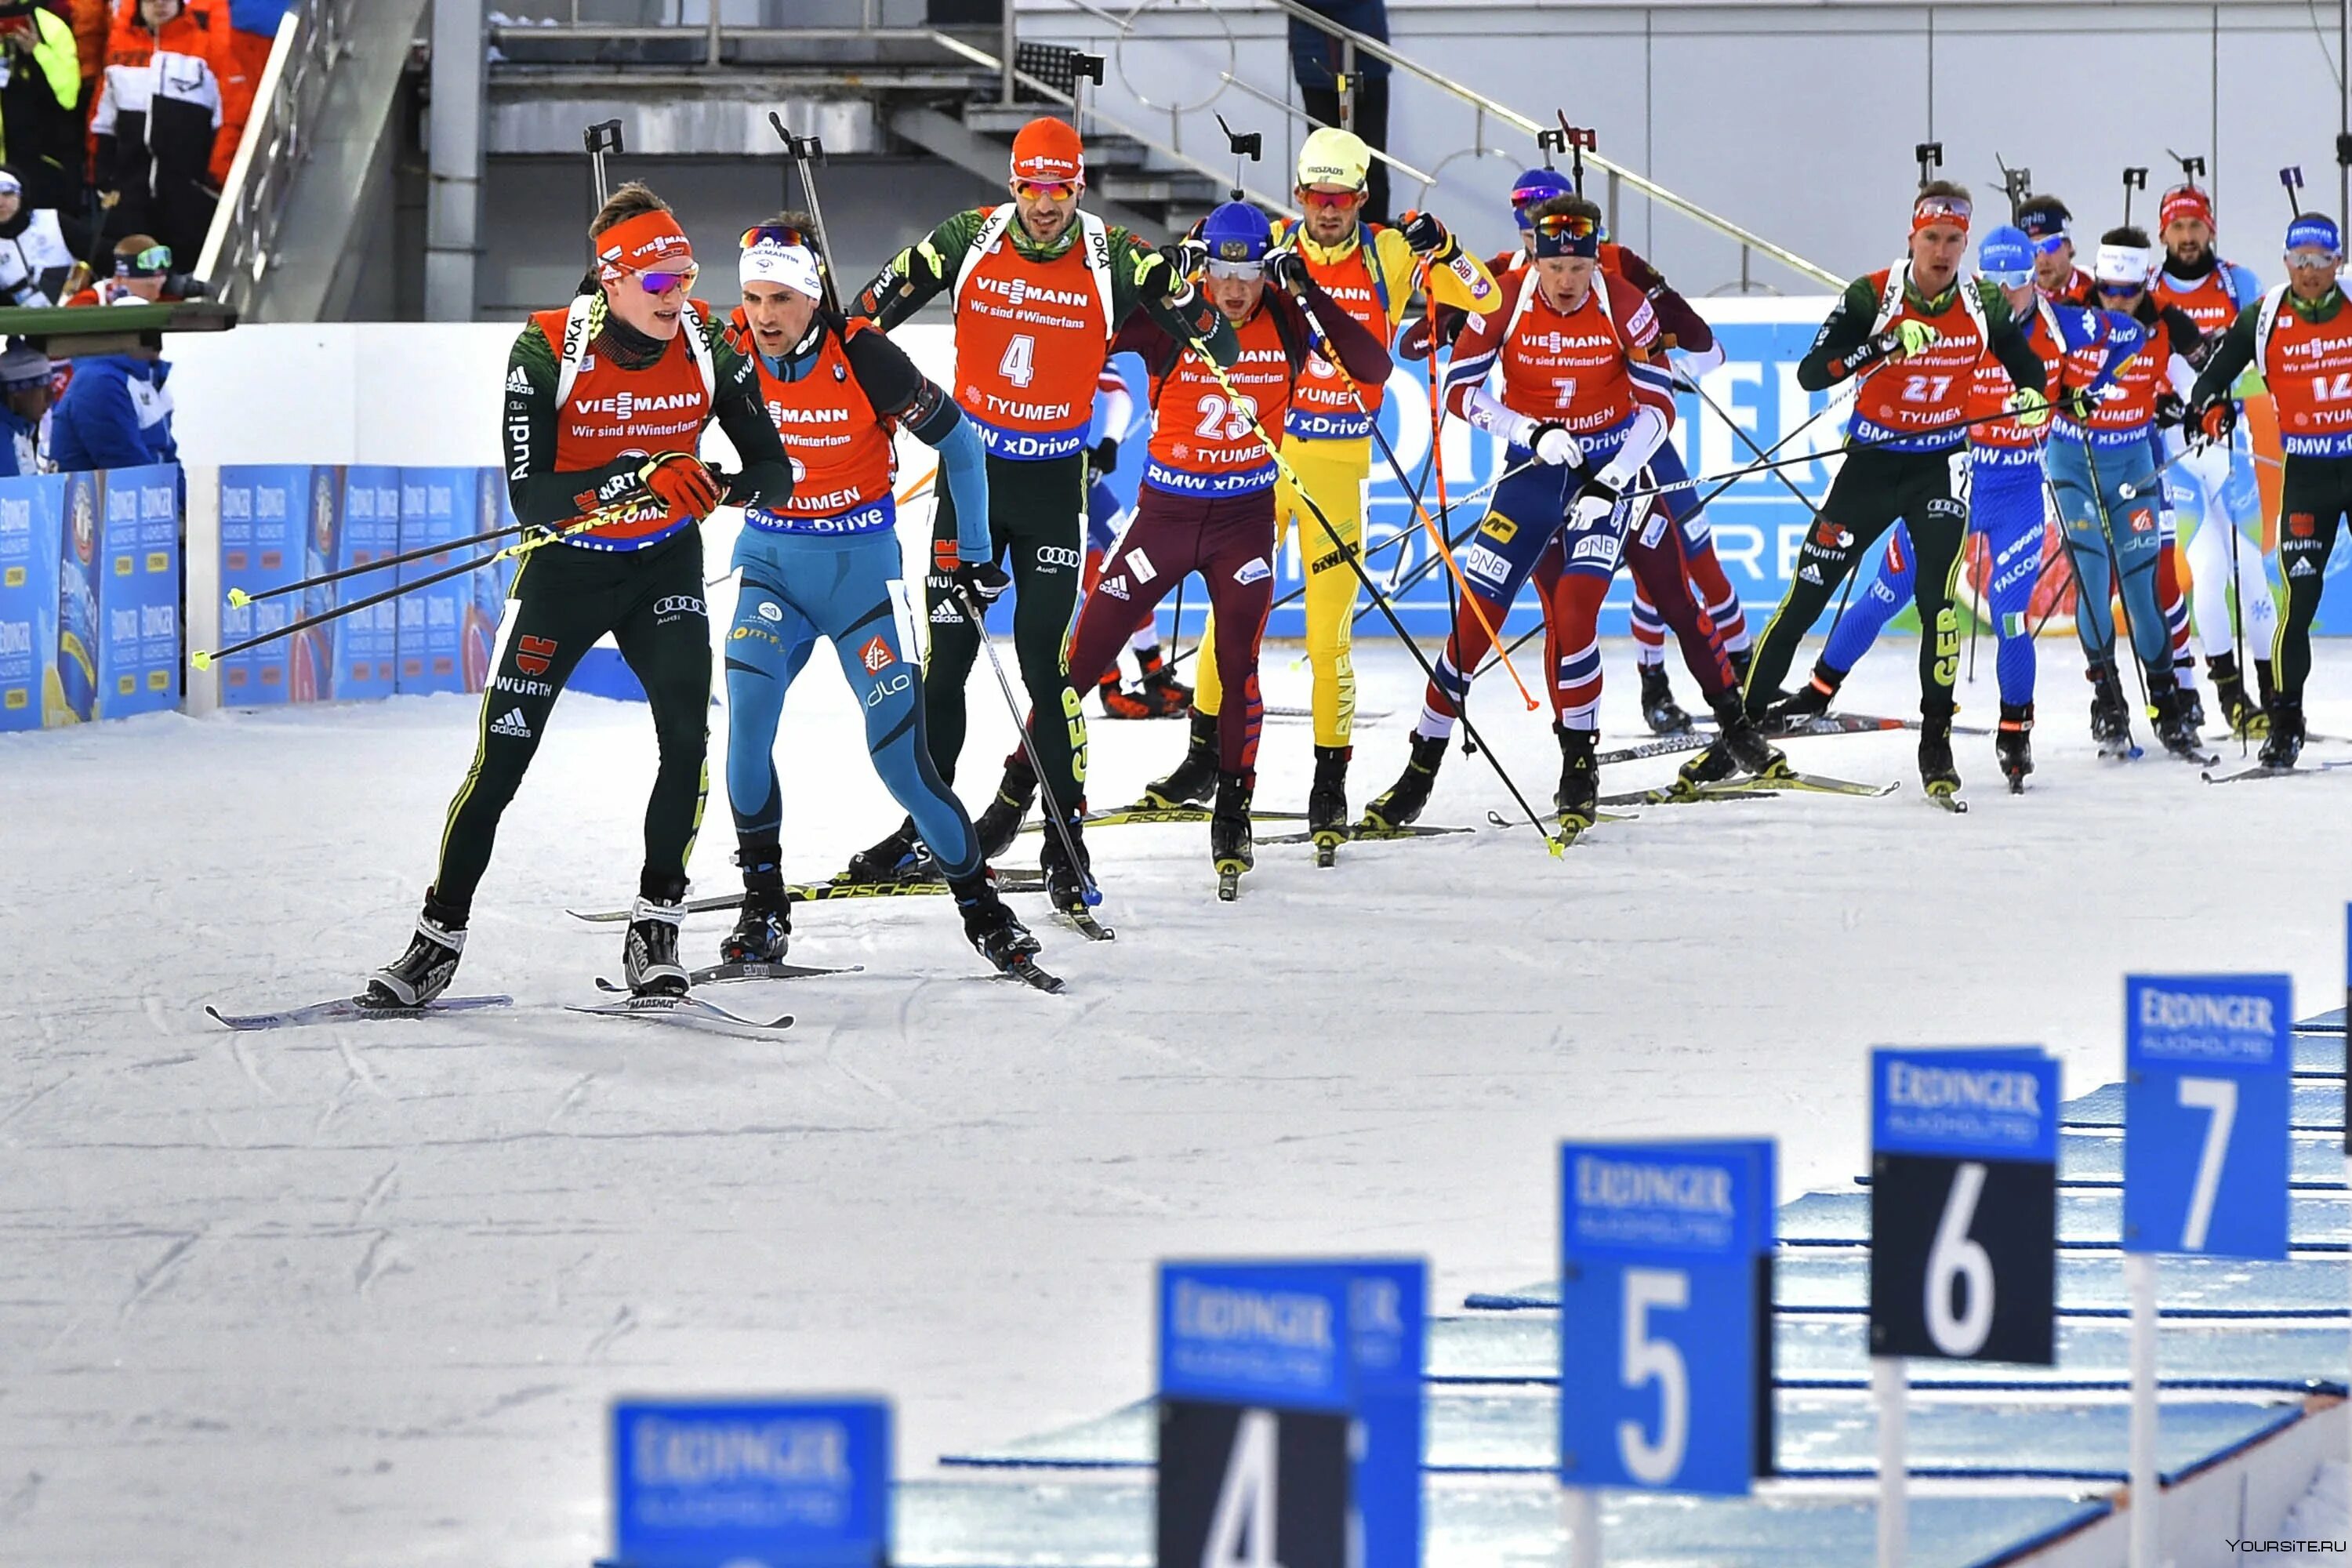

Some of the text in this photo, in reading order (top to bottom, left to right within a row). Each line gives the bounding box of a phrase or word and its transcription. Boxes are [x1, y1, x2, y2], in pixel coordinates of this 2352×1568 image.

[971, 215, 1002, 251] JOKA
[1089, 231, 1111, 270] JOKA
[975, 276, 1089, 307] VIESSMANN
[970, 299, 988, 313] Wir
[989, 305, 1014, 321] sind
[562, 317, 585, 363] JOKA
[684, 309, 712, 353] JOKA
[1521, 331, 1612, 354] VIESSMANN
[998, 333, 1036, 389] 4
[506, 381, 535, 394] adidas
[1179, 371, 1199, 383] Wir
[1901, 375, 1953, 404] 27
[575, 391, 702, 420] VIESSMANN
[1552, 377, 1577, 408] 7
[985, 394, 1070, 421] TYUMEN
[1195, 394, 1259, 441] 23
[572, 419, 699, 438] Wir sind #Winterfans
[1299, 417, 1369, 434] xDrive
[509, 415, 530, 481] Audi
[2286, 437, 2332, 455] BMW
[1468, 547, 1506, 577] DNB
[1576, 536, 1616, 559] DNB
[1036, 564, 1058, 575] Audi
[1098, 583, 1131, 601] adidas
[657, 615, 681, 626] Audi
[929, 614, 964, 624] adidas
[1933, 608, 1960, 687] GER
[496, 676, 553, 697] WÜRTH
[490, 722, 532, 739] adidas
[1061, 686, 1087, 783] GER
[1125, 812, 1206, 824] FISCHER
[629, 998, 675, 1010] MADSHUS
[2138, 986, 2275, 1035] ERDINGER
[1887, 1059, 2042, 1118] ERDINGER
[2177, 1076, 2239, 1251] 7
[1574, 1154, 1736, 1220] ERDINGER
[1924, 1160, 1997, 1359] 6
[1616, 1267, 1692, 1486] 5
[1198, 1409, 1290, 1568] 4
